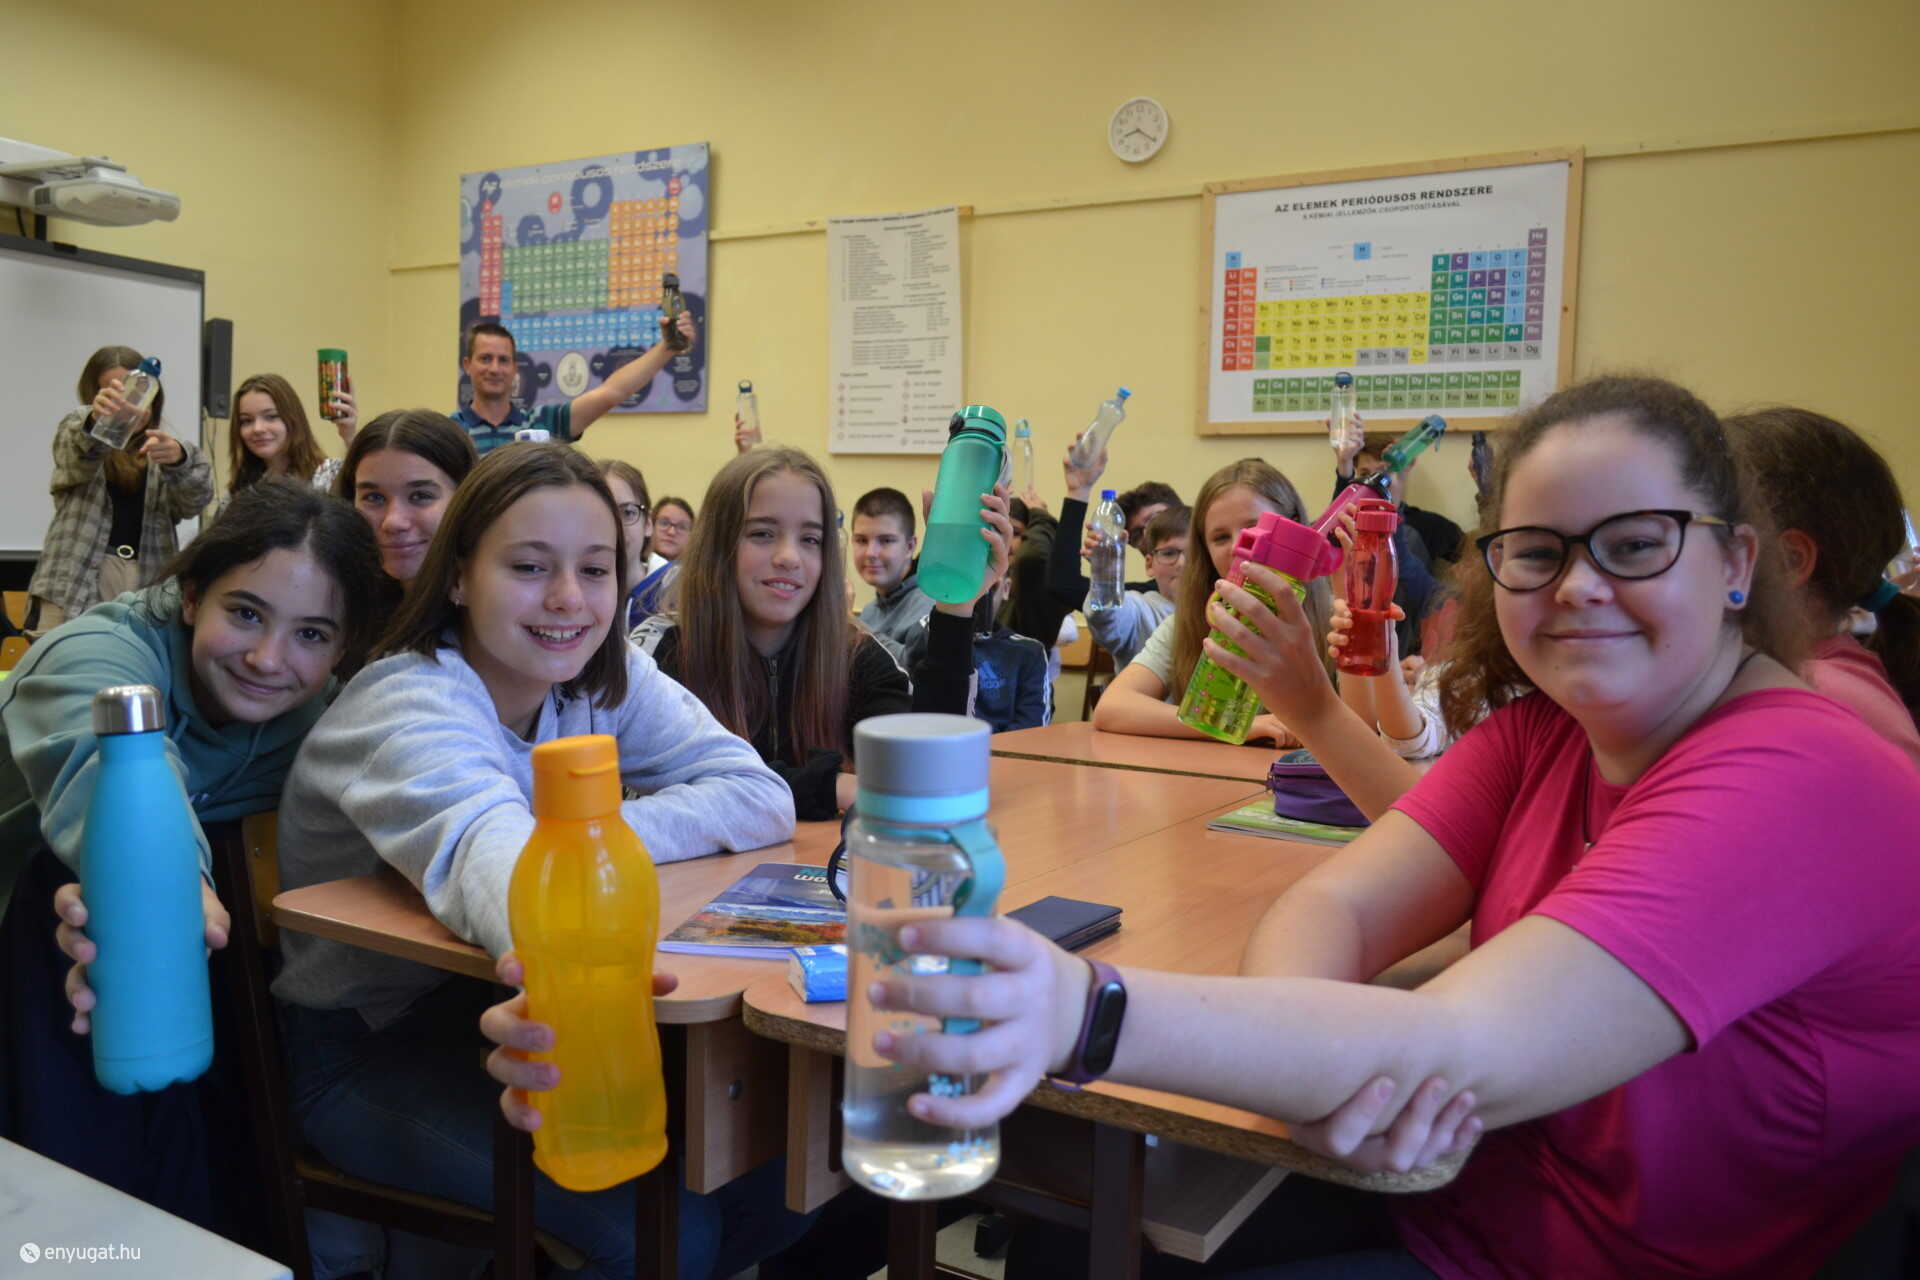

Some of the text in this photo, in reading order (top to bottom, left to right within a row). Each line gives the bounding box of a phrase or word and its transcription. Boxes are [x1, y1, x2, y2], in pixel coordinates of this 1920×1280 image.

[1274, 184, 1494, 213] AZ ELEMEK PERIÓDUSOS RENDSZERE
